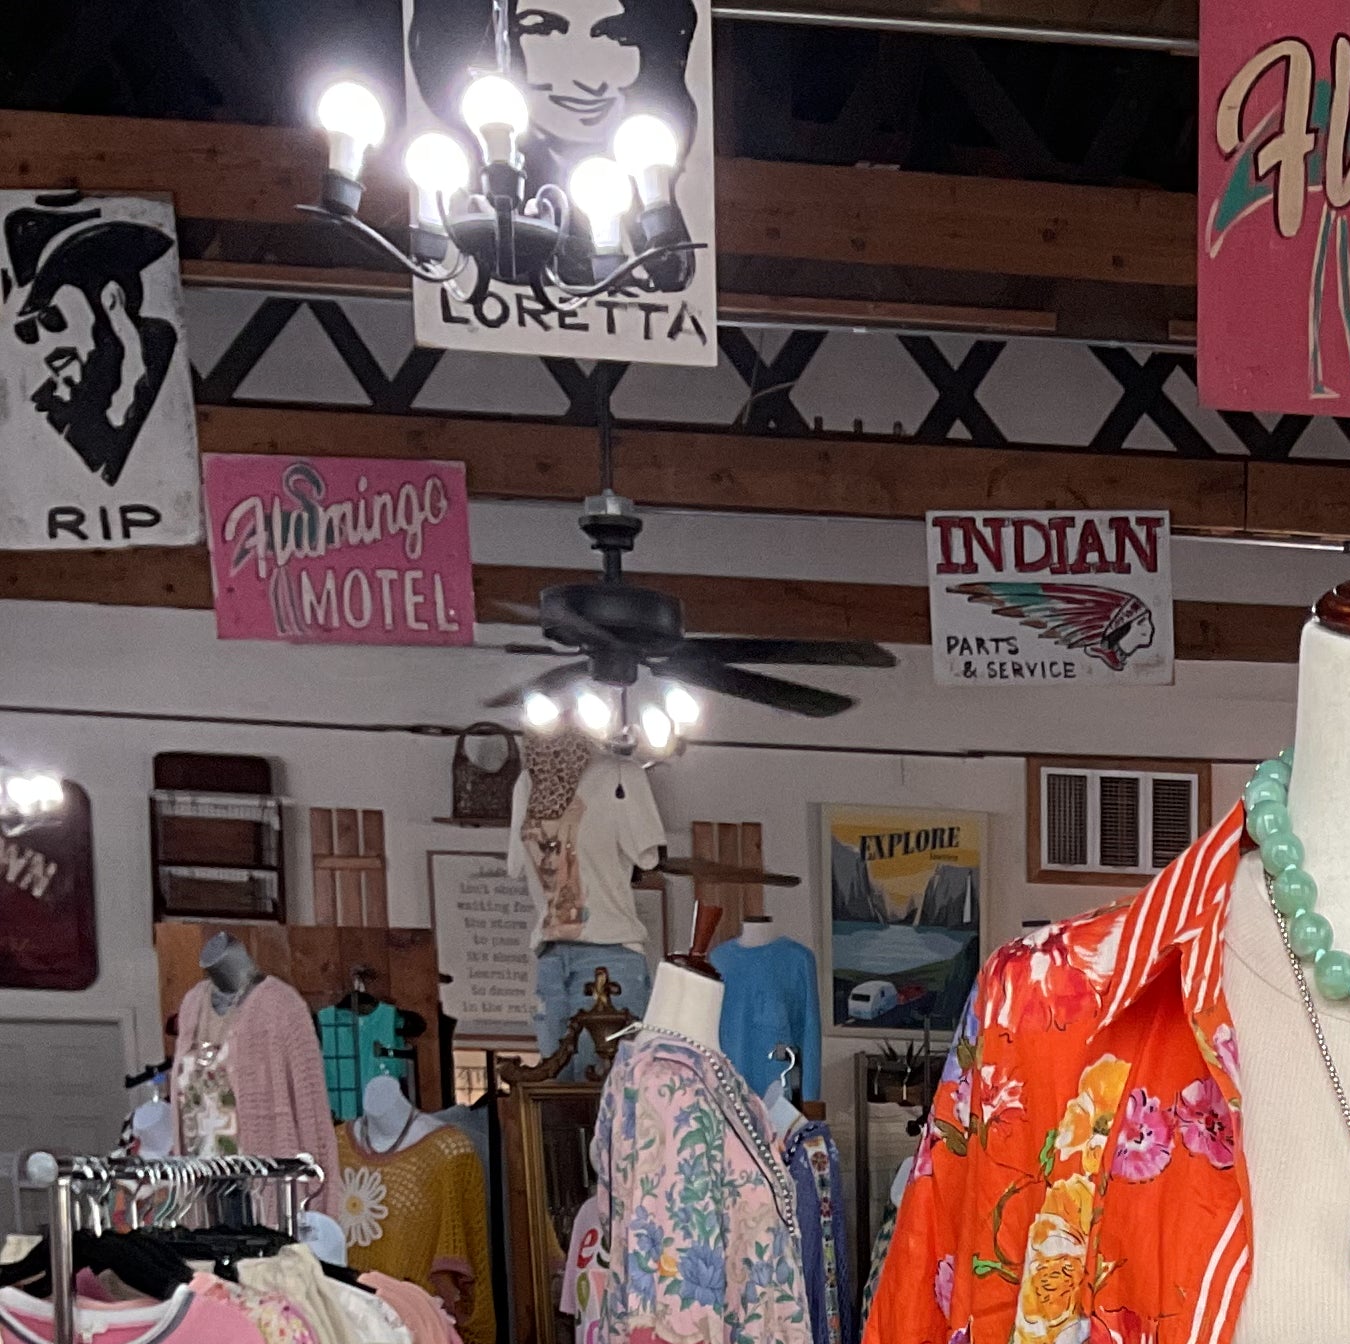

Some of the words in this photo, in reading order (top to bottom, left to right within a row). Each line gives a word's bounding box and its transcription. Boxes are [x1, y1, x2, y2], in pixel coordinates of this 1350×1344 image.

[440, 287, 707, 346] LORETTA
[47, 504, 162, 541] RIP
[225, 476, 448, 579] Flamingo
[932, 516, 1167, 574] INDIAN
[301, 568, 460, 632] MOTEL
[946, 635, 1020, 657] PARTS
[963, 660, 978, 679] &
[987, 660, 1077, 680] SERVICE
[859, 827, 961, 861] EXPLORE
